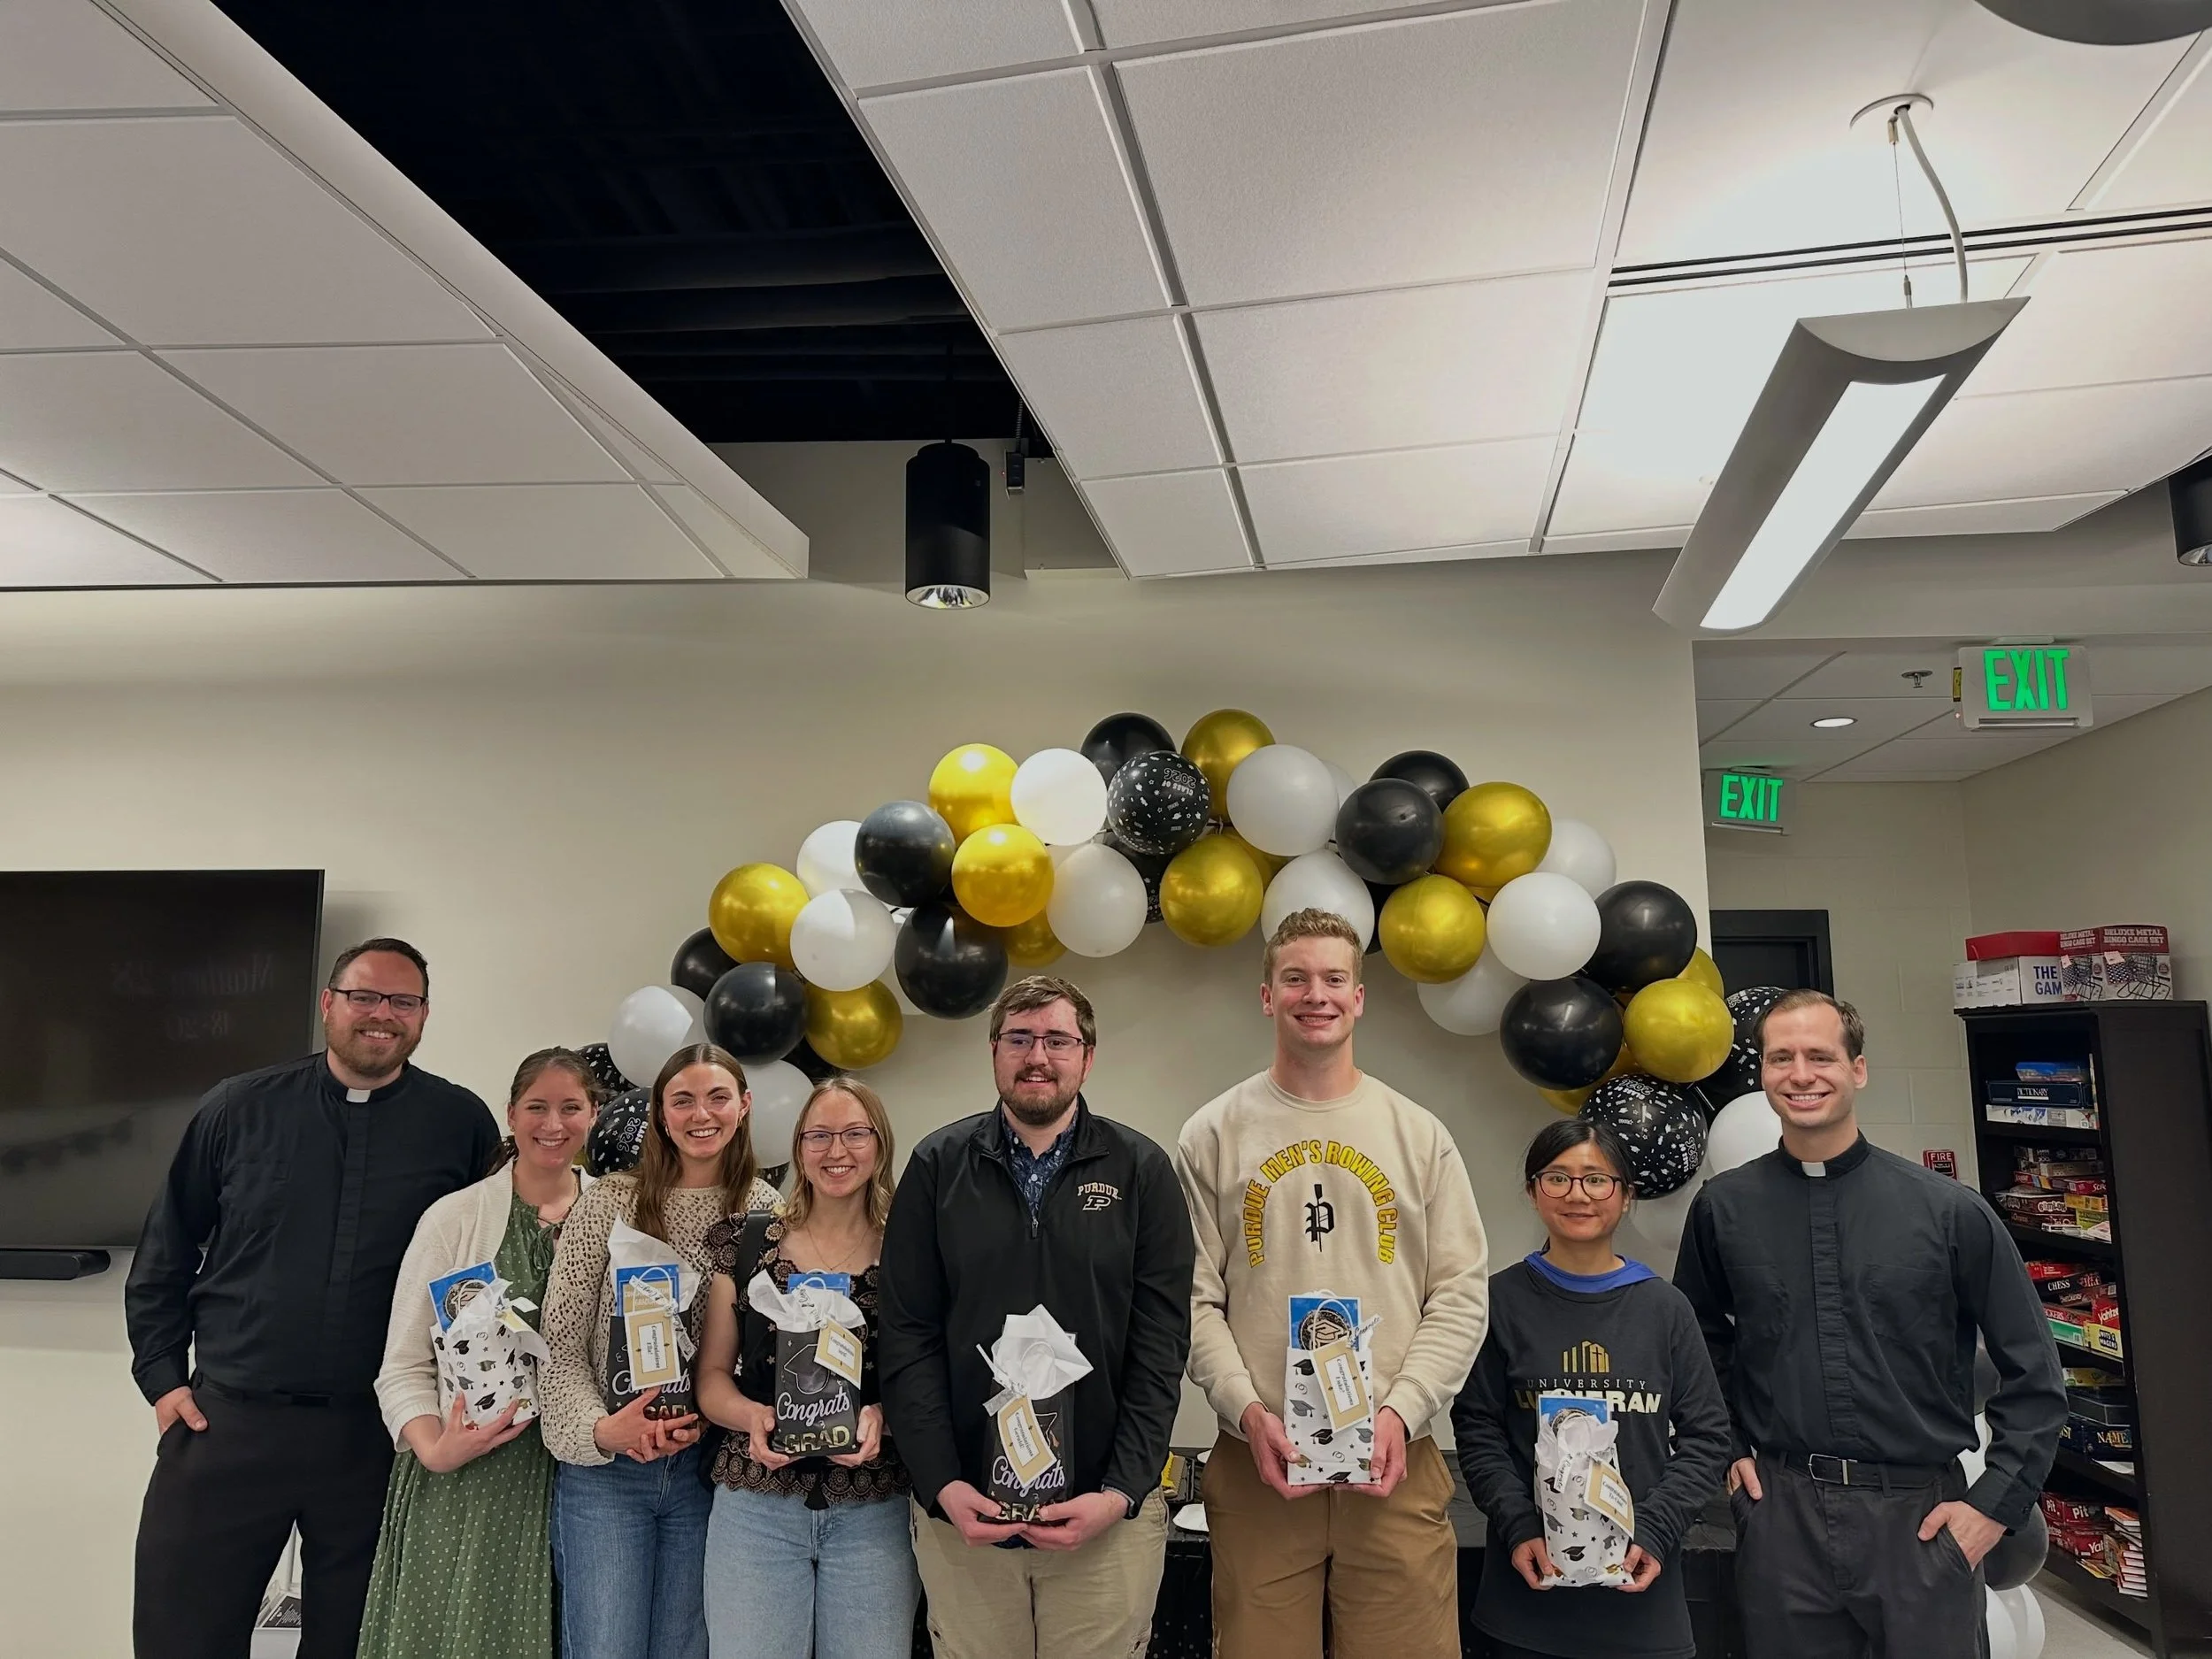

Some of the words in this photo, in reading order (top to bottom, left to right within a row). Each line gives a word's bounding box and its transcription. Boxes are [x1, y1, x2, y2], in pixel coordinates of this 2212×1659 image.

[1984, 649, 2069, 710] EXIT
[1164, 768, 1196, 788] 2026
[1172, 783, 1194, 796] CLASS
[1720, 774, 1783, 822] EXIT
[2033, 965, 2057, 979] THE
[2035, 981, 2062, 995] GAM
[617, 1117, 641, 1152] 2026
[634, 1121, 649, 1142] CLASS
[631, 1144, 640, 1156] OF
[1078, 1182, 1118, 1200] PURDUE
[1082, 1195, 1111, 1210] P
[1243, 1179, 1271, 1268] PURDUE
[1259, 1140, 1323, 1183] MEN'S
[1325, 1141, 1395, 1207] ROWING
[1377, 1208, 1398, 1265] CLUB
[2047, 1279, 2070, 1292] CHESS
[1337, 1358, 1354, 1406] Congratulations
[1527, 1379, 1647, 1390] UNIVERSITY
[776, 1386, 850, 1427] Congrats
[1515, 1389, 1662, 1414] LURAN
[784, 1425, 850, 1454] GRAD
[2097, 1431, 2128, 1444] NAME
[2046, 1499, 2056, 1513] Pit
[2071, 1504, 2089, 1519] Pit
